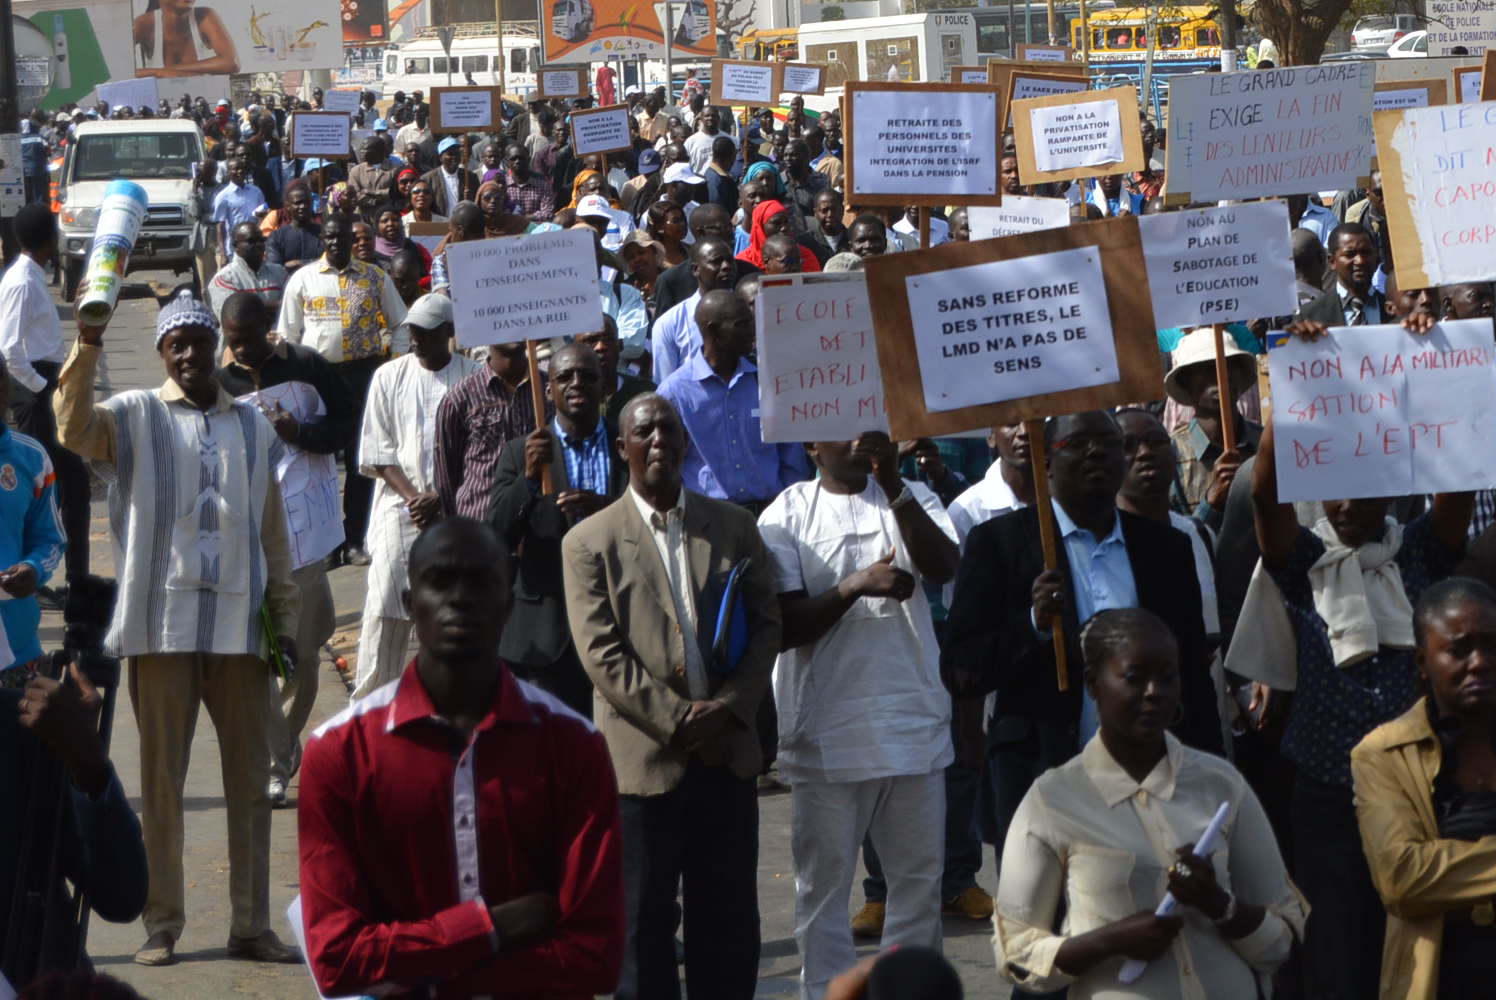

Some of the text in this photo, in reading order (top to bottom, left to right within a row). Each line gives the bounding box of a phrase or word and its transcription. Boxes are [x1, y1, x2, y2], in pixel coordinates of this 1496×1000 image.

[945, 15, 969, 25] POLICE
[1456, 16, 1480, 26] POLICE
[1439, 32, 1448, 42] DE
[1449, 32, 1458, 41] LA
[1209, 63, 1357, 97] LE GRAND CADRE
[1055, 111, 1096, 123] NON A LA
[1209, 91, 1342, 130] EXIGE LA FIN
[1438, 106, 1474, 133] LE
[887, 118, 962, 127] RETRAITE DES
[1044, 121, 1110, 135] PRIVATISATION
[878, 132, 972, 141] PERSONNELS DES
[1047, 131, 1108, 145] RAMPANTE DE
[887, 145, 958, 153] UNIVERSITES
[1049, 143, 1107, 156] L'UNIVERSITE
[1205, 142, 1233, 161] DES
[870, 158, 949, 166] INTEGRATION DE
[1436, 149, 1473, 172] DIT
[883, 169, 968, 177] DANS LA PENSION
[999, 215, 1044, 225] RETRAIT DU
[1186, 213, 1236, 229] NON AU
[1187, 232, 1241, 249] PLAN DE
[508, 256, 542, 270] DANS
[1173, 252, 1257, 273] SABOTAGE DE
[1175, 275, 1259, 295] L'EDUCATION
[473, 293, 588, 318] 10 000 ENSEIGNANTS
[938, 281, 1081, 313] SANS REFORME
[1200, 298, 1240, 315] (PSE)
[493, 310, 571, 331] DANS LA RUE
[776, 297, 858, 325] ECOLE
[941, 304, 1082, 336] DES TITRES, LE
[941, 326, 1088, 360] LMD N'A PAS DE
[993, 356, 1043, 375] SENS
[1288, 353, 1404, 381] NON A LA
[792, 397, 841, 421] NON
[1288, 387, 1398, 421] SATION
[1293, 438, 1335, 469] DE
